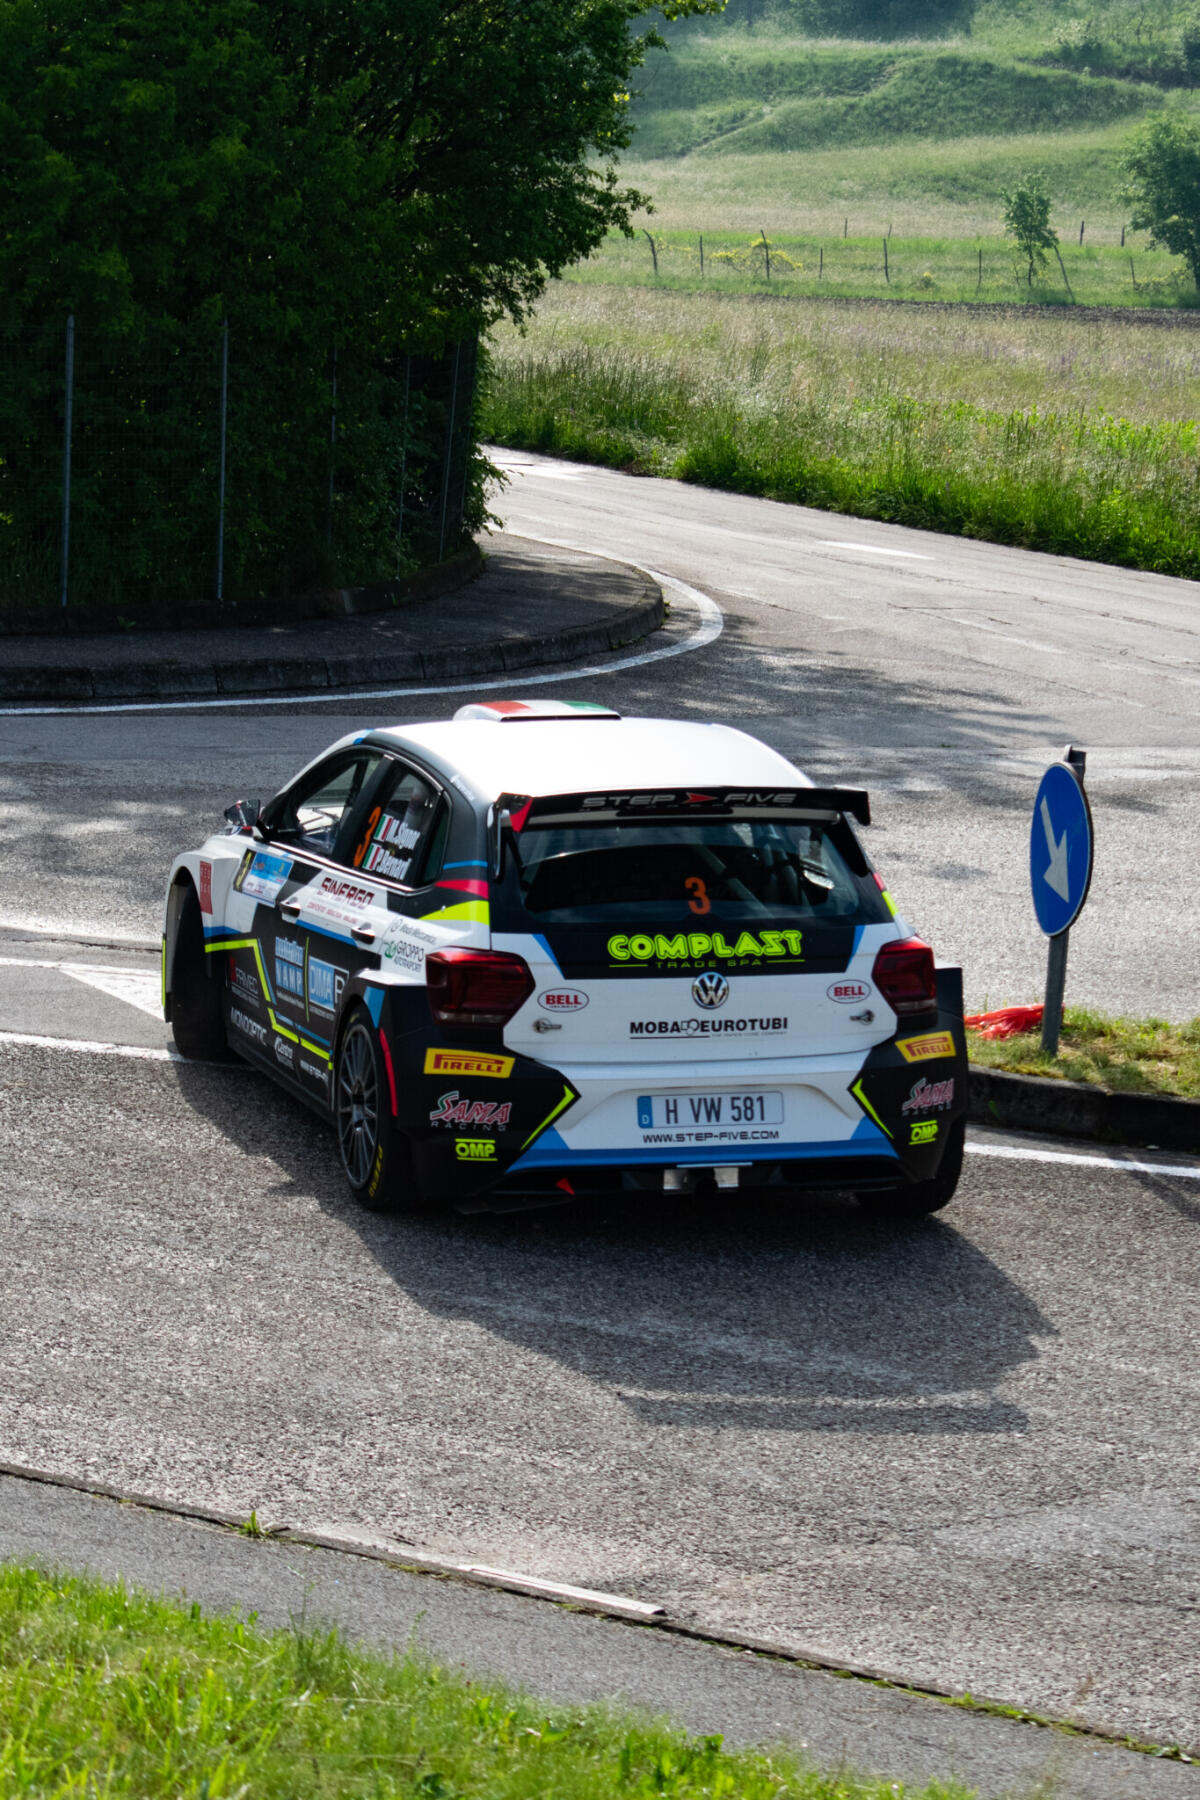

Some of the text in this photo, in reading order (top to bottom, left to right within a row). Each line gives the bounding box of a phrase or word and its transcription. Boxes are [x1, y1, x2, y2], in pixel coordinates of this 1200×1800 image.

[582, 795, 676, 807] STEP
[723, 792, 797, 803] FIVE
[353, 805, 382, 867] 3
[684, 876, 712, 915] 3
[607, 930, 802, 961] COMPLAST
[655, 958, 762, 969] TRADE SPA
[545, 994, 582, 1005] BELL
[833, 985, 865, 997] BELL
[629, 1016, 788, 1035] MOBA EUROTUBI
[905, 1037, 951, 1057] PIRELLI
[433, 1054, 505, 1073] PIRELLI
[902, 1077, 954, 1110] SAMA
[430, 1090, 512, 1125] SAMA
[665, 1098, 679, 1124] H
[689, 1097, 722, 1123] VW
[731, 1095, 766, 1122] 581
[430, 1120, 507, 1132] RACING
[911, 1124, 938, 1142] OMP
[643, 1130, 780, 1143] WWW.STEP-FIVE.COM
[455, 1142, 496, 1159] OMP
